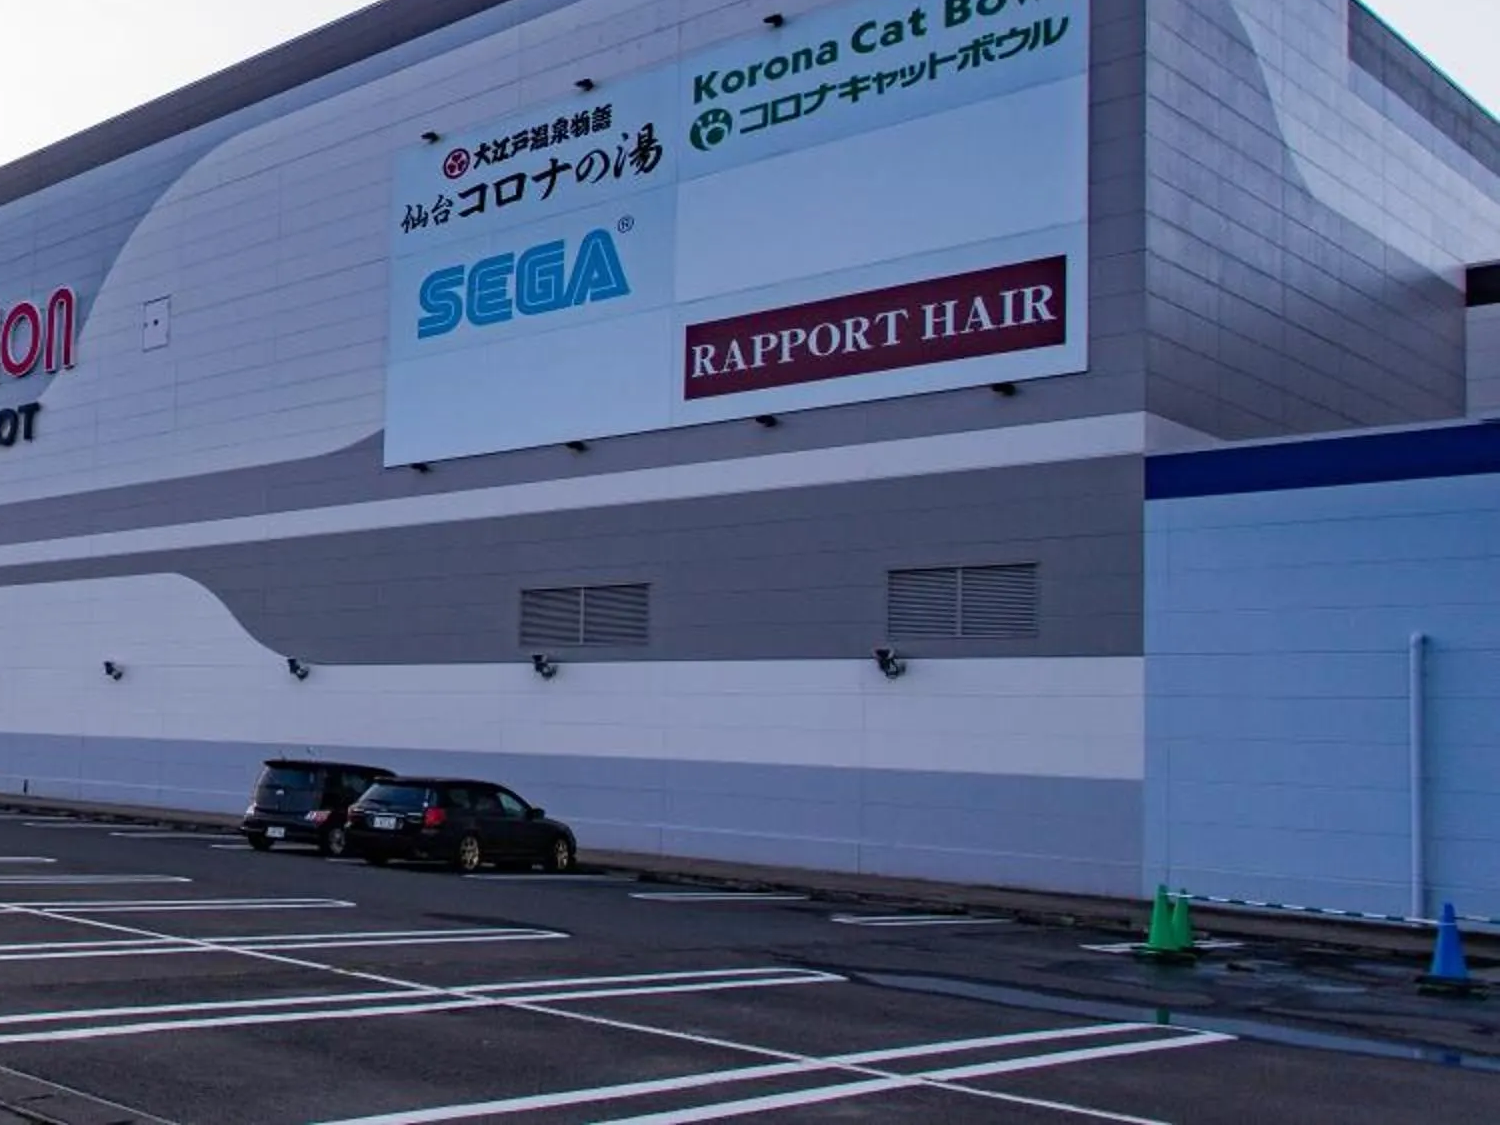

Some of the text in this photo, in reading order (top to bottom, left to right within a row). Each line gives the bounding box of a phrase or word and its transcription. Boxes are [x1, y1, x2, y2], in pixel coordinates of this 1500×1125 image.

[694, 40, 838, 104] Korona
[851, 7, 928, 54] Cat
[740, 16, 1069, 134] コロナキャットボウル
[473, 103, 612, 169] 大江戸温泉物語
[417, 228, 631, 340] SEGA
[691, 284, 1057, 378] RAPPORT HAIR
